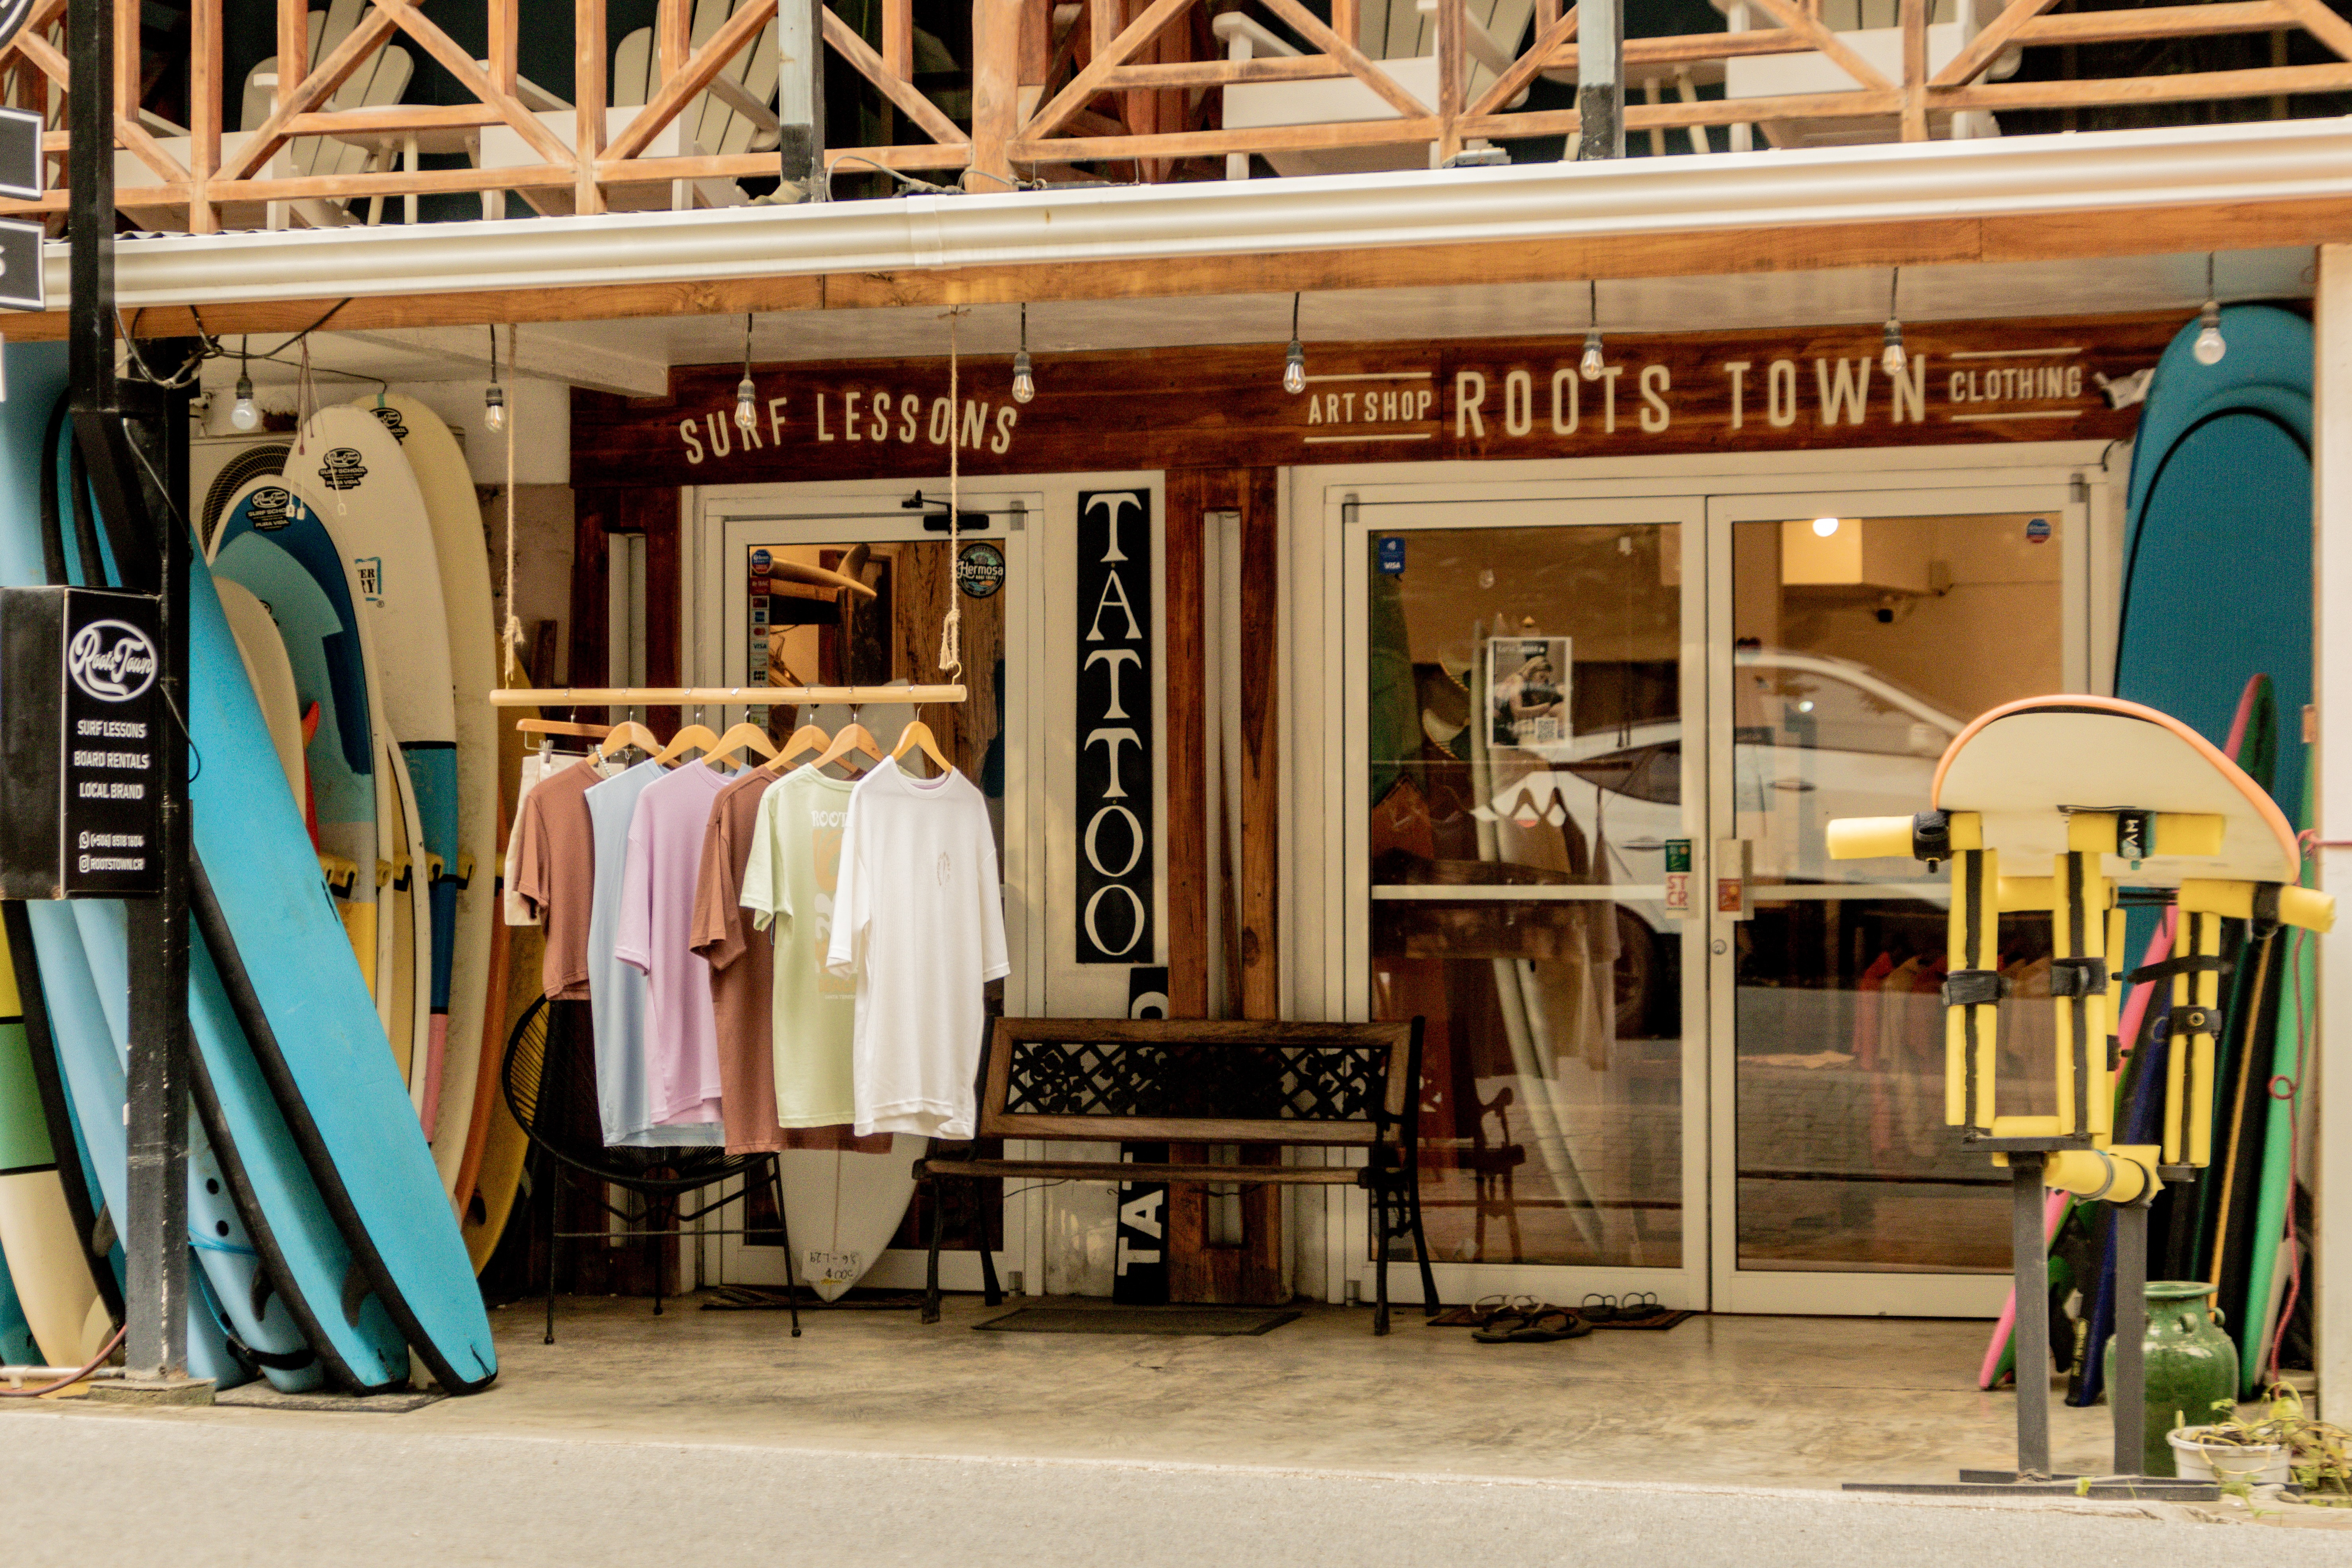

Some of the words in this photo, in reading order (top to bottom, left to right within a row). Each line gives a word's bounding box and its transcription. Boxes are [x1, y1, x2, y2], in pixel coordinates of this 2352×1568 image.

[1724, 354, 1926, 430] TOWN
[1949, 365, 2083, 403] CLOTHING
[1308, 392, 1356, 424] ART
[1364, 389, 1433, 423] SHOP
[1456, 364, 1672, 438] ROOTS
[679, 396, 789, 465] SURF
[817, 391, 1017, 455] LESSONS
[358, 569, 375, 578] ER
[956, 560, 1004, 579] Hermosa
[110, 637, 152, 683] Town
[77, 719, 103, 736] SURF
[103, 721, 147, 738] LESSONS
[1085, 492, 1145, 956] TATTOO
[74, 751, 105, 767] BOARD
[107, 753, 150, 769] RENTALS
[80, 783, 109, 798] LOCAL
[110, 783, 144, 799] BRAND
[811, 810, 848, 827] ROOT
[90, 834, 111, 847] (+506)
[112, 835, 127, 847] 8518
[128, 835, 144, 847] 1604
[1667, 875, 1688, 890] ST
[1667, 891, 1688, 906] CR
